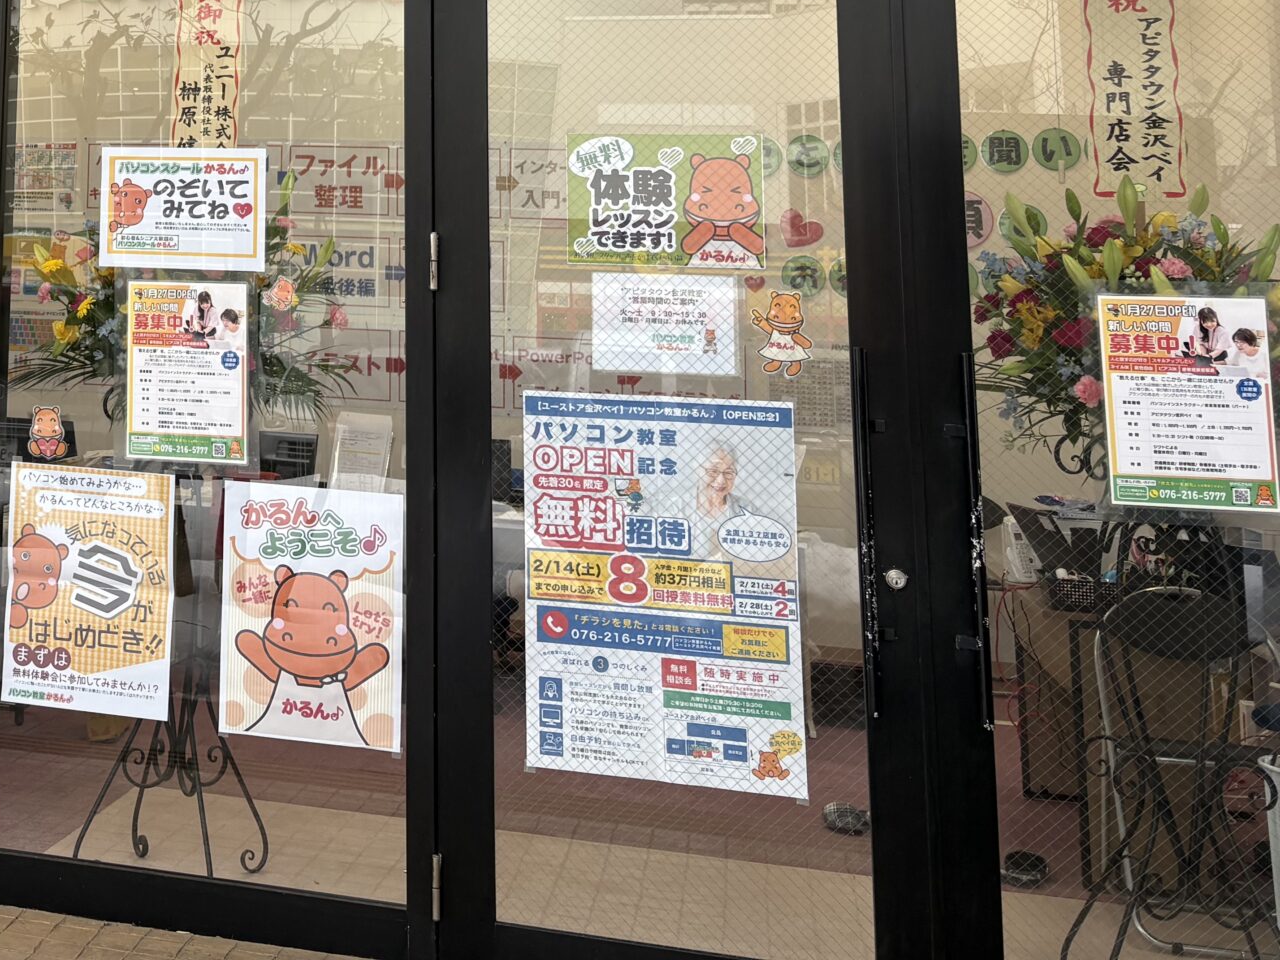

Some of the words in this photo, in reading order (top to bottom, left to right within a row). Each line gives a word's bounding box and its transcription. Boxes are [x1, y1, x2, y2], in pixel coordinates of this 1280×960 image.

[195, 3, 223, 46] 御祝
[201, 63, 214, 136] 代表取締役社長
[1137, 16, 1175, 182] アピタタウン金沢ベイ
[1103, 61, 1140, 172] 専門店会
[295, 154, 385, 177] ファイル
[576, 139, 625, 172] 無料
[119, 162, 202, 175] パソコンスクール
[153, 178, 249, 199] のぞいて
[314, 184, 363, 209] 整理
[589, 168, 675, 207] 体験
[162, 200, 229, 219] みてね
[592, 209, 675, 229] レッスン
[591, 231, 674, 250] できます!
[699, 249, 738, 263] かるん
[143, 289, 197, 299] 1月27日OPEN
[134, 303, 178, 312] 新しい仲間
[1119, 304, 1197, 317] 1月27日OPEN
[134, 314, 194, 332] 募集中!
[1107, 320, 1172, 333] 新しい仲間
[1109, 334, 1196, 356] 募集中!
[532, 421, 677, 447] パソコン教室
[161, 444, 208, 454] 076-216-5777
[533, 445, 634, 476] OPEN
[638, 457, 677, 476] 記念
[23, 471, 143, 490] パソコン始めてみようかな…
[538, 477, 581, 488] 先着30名
[583, 478, 604, 490] 限定
[39, 493, 164, 514] かるんってどんなところかな…
[1159, 490, 1226, 501] 076-216-5777
[241, 497, 343, 529] かるんへ
[533, 492, 623, 542] 無料
[625, 517, 688, 548] 招待
[65, 519, 166, 587] 気になっている
[259, 528, 361, 559] ようこそ
[533, 559, 601, 577] 2/14(土)
[236, 573, 269, 592] みんな
[608, 554, 648, 603] 8
[655, 573, 726, 589] 約3万円相当
[242, 590, 272, 605] 一緒に
[535, 583, 604, 595] までの申し込みで
[652, 589, 734, 608] 回授業料無料
[133, 600, 153, 623] が
[354, 602, 390, 628] Let's
[28, 618, 163, 655] はじめどき!!
[352, 615, 382, 640] try!
[571, 629, 671, 647] 076-216-5777
[17, 645, 69, 667] まずは
[612, 662, 647, 672] つのしくみ
[671, 664, 687, 673] 無料
[704, 667, 780, 684] 随時実施中
[12, 667, 159, 694] 無料体験会に参加してみませんか!?
[666, 676, 692, 685] 相談会
[282, 698, 330, 721] かるん
